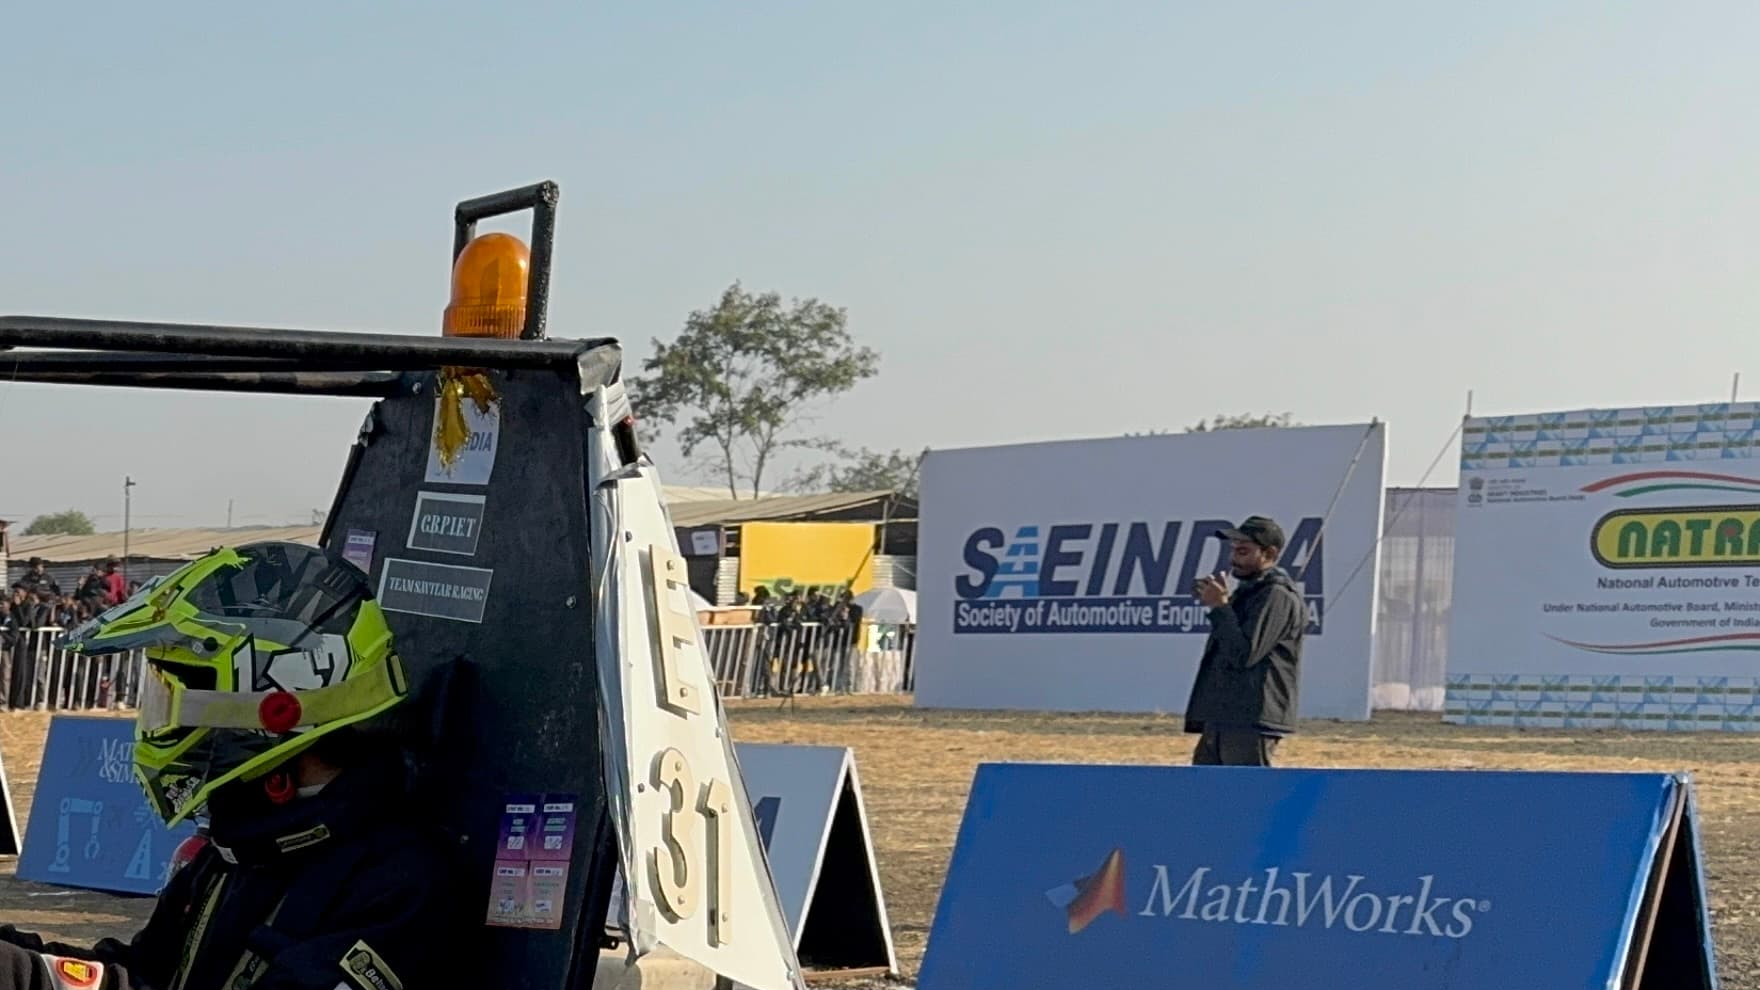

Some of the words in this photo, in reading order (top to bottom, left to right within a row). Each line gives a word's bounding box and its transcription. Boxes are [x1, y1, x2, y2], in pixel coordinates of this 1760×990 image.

[955, 517, 1324, 600] SAEINDA
[389, 576, 415, 593] TEAM
[1597, 577, 1654, 589] National
[1657, 576, 1739, 589] Automotive
[958, 601, 1021, 632] Society
[1024, 602, 1044, 627] of
[1046, 600, 1153, 627] Automotive
[1157, 599, 1211, 632] Engin
[1543, 602, 1574, 613] Under
[1577, 602, 1620, 613] National
[1622, 602, 1683, 613] Automotive
[1686, 601, 1721, 614] Board,
[1650, 616, 1717, 628] Government
[1719, 616, 1731, 628] of
[654, 748, 731, 945] 31
